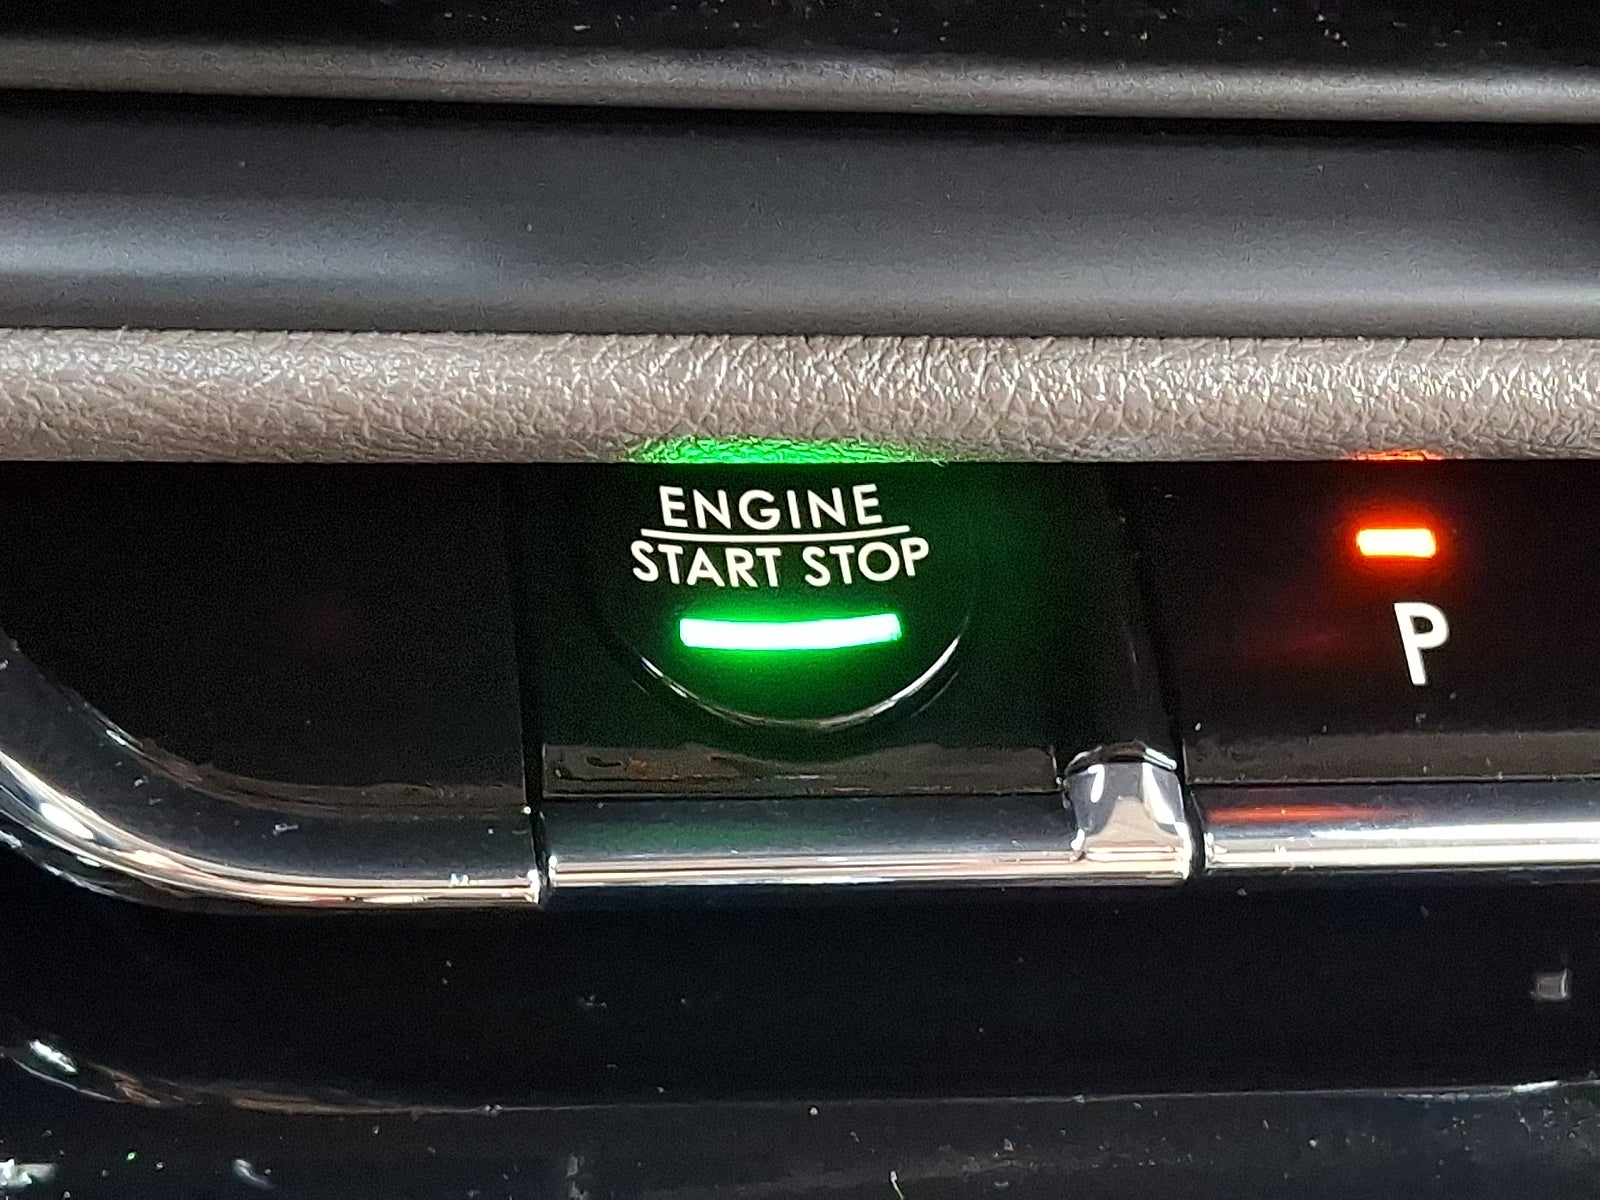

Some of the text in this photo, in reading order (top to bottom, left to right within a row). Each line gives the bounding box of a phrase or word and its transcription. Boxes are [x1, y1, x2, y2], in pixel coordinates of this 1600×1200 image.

[658, 483, 884, 531] ENGINE
[630, 536, 930, 588] START STOP
[1393, 601, 1450, 686] P
